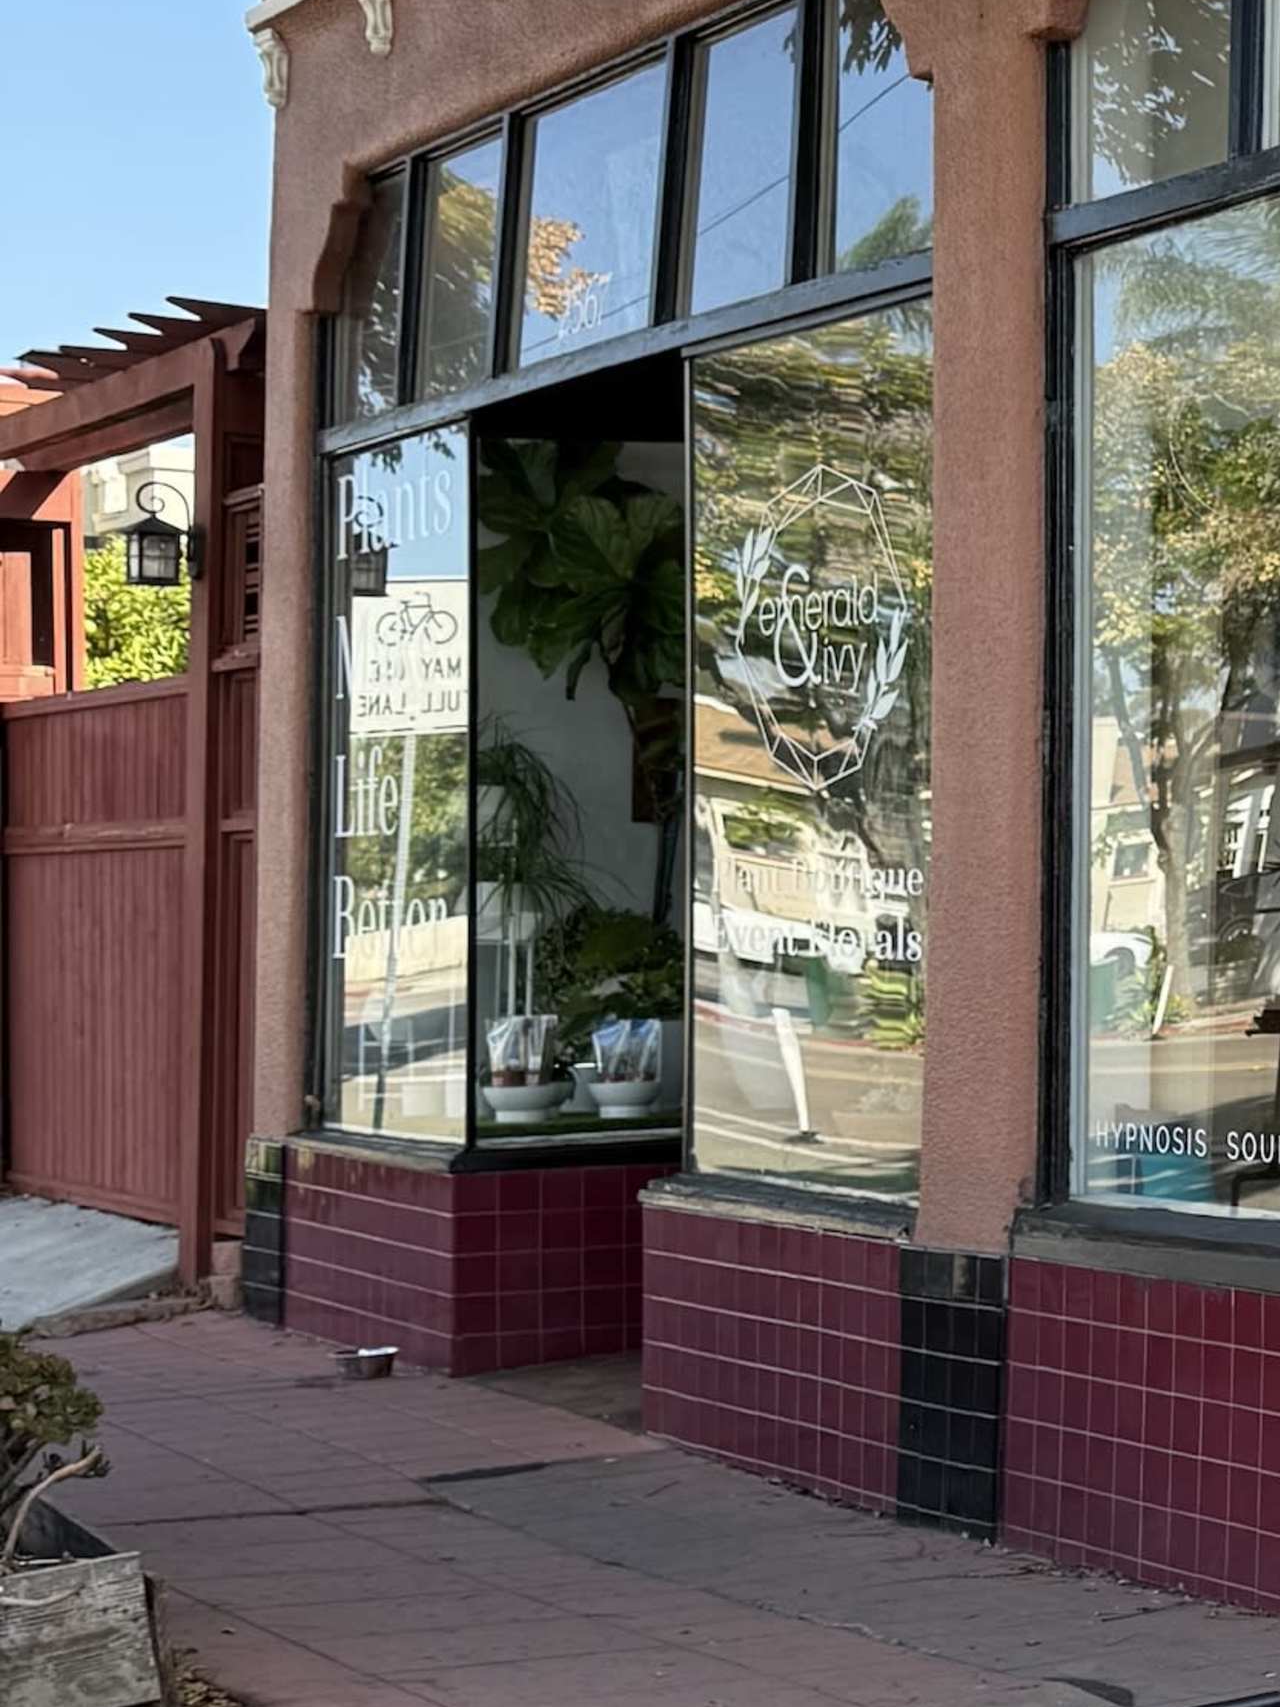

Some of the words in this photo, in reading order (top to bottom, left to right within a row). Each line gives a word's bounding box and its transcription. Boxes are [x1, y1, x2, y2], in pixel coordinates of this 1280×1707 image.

[336, 466, 453, 561] Plants
[758, 571, 879, 636] emerald
[774, 564, 822, 687] &
[822, 636, 868, 692] ivy
[335, 745, 398, 838] Life
[1095, 1120, 1207, 1158] HYPNOSIS
